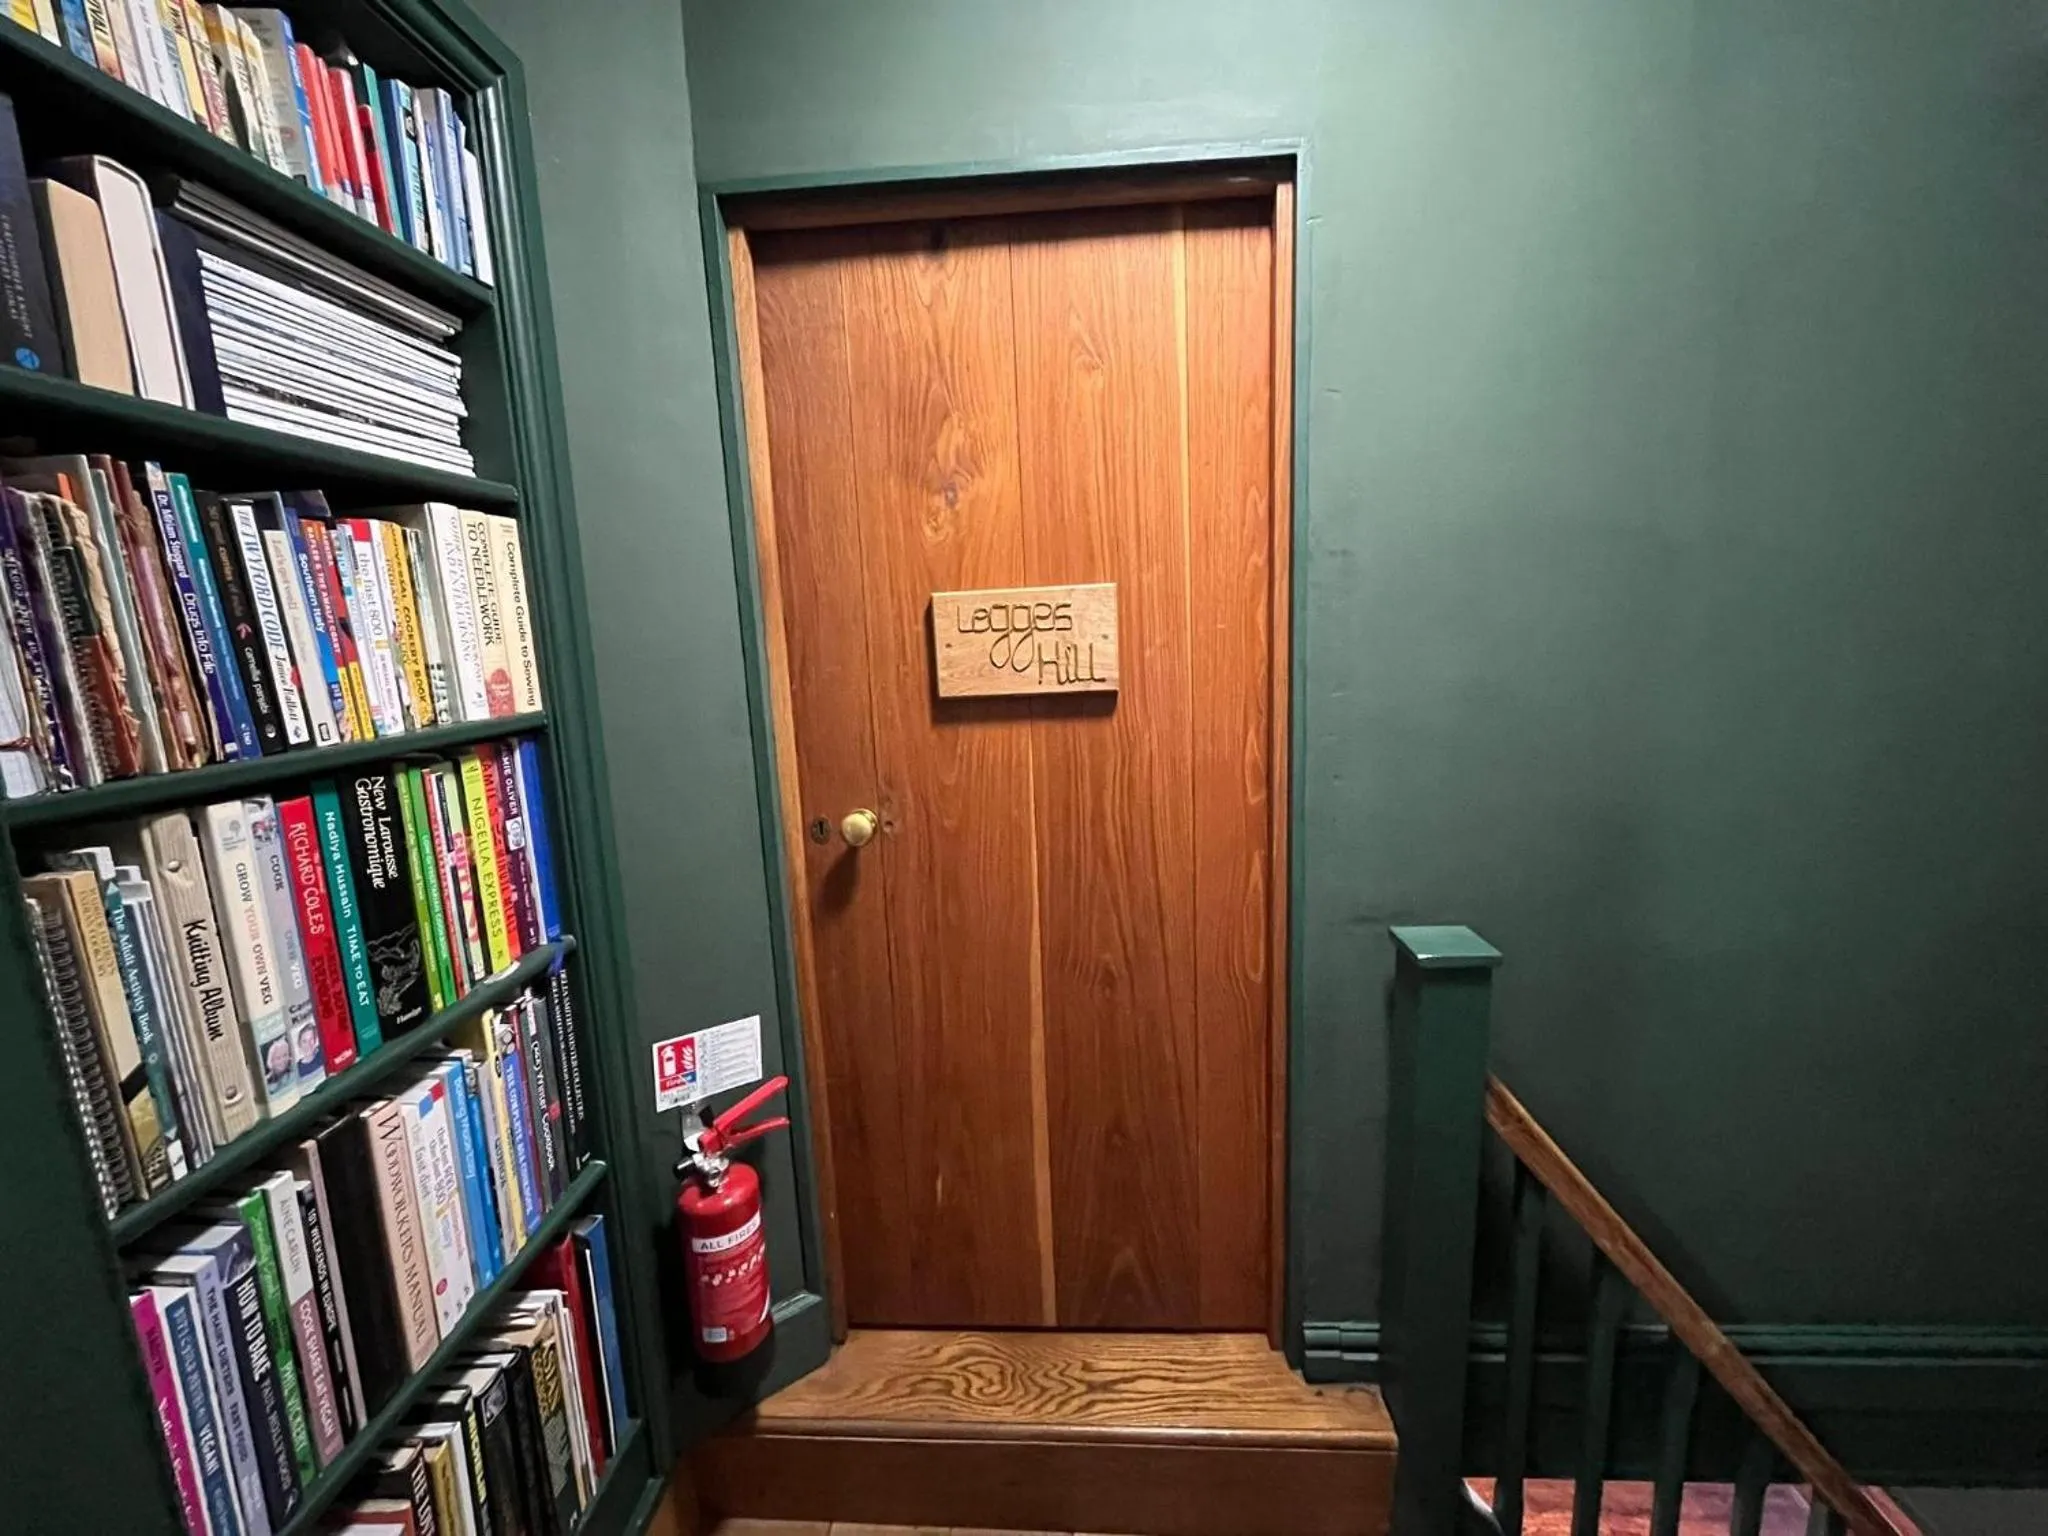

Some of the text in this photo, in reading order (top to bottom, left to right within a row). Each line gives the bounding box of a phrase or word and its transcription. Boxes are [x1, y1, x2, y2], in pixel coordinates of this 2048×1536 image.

[156, 492, 189, 579] Dr. Miriam Stoppard
[306, 526, 319, 560] NAPLES
[241, 528, 274, 610] TWYFORD
[262, 608, 285, 651] CODE
[298, 551, 319, 607] Southern
[311, 607, 325, 633] Italy
[316, 572, 326, 588] THE
[320, 590, 334, 623] AMALFI
[358, 552, 383, 636] the fast 800
[466, 522, 495, 646] TO NEEDLEWORK
[478, 521, 501, 642] COMPLETE GUIDE
[182, 591, 215, 675] Drugs Info File
[329, 624, 341, 653] COAST
[504, 540, 537, 706] Complete Guide to Sewing
[273, 653, 293, 686] Janice
[402, 605, 420, 665] COOKERY
[414, 669, 426, 702] BOOK
[1038, 641, 1106, 685] Hill
[504, 777, 518, 814] OLIVER
[285, 821, 318, 885] RICHARD
[356, 778, 387, 889] Gastronomique
[371, 776, 397, 878] New Larousse
[321, 810, 343, 860] Nadiya
[333, 863, 353, 918] Hussain
[470, 797, 503, 937] NIGELLA EXPRESS
[233, 860, 273, 1005] GROW YOUR OWN VEG
[268, 854, 285, 891] COOK
[288, 961, 304, 989] VEG
[300, 884, 327, 936] COLES
[111, 905, 156, 1044] The Adult Activity Book
[183, 918, 225, 1042] Knitting Album
[344, 924, 369, 1005] TIME TO EAT
[505, 1064, 516, 1089] THE
[567, 1032, 578, 1065] WINTER
[508, 1089, 524, 1140] COMPLETE
[535, 1071, 549, 1110] Winter
[413, 1146, 428, 1170] fast
[430, 1158, 443, 1179] fast
[438, 1144, 451, 1166] fast
[541, 1115, 557, 1171] Cookbook
[417, 1171, 435, 1198] diet
[518, 1162, 534, 1214] COOKBOOK
[306, 1208, 317, 1224] 101
[700, 1222, 757, 1250] ALL FIRES
[308, 1225, 329, 1280] WEEKENDS
[233, 1278, 274, 1381] HOW TO BAKE
[320, 1291, 339, 1331] EUROPE
[403, 1262, 428, 1342] MANUAL
[204, 1286, 235, 1396] THE HAIRY DIETERS
[298, 1297, 335, 1437] COOK SHARE EAT VEGAN
[278, 1361, 298, 1395] PHIL
[228, 1402, 242, 1429] FAST
[258, 1377, 295, 1491] PAUL HOLLYWOOD
[411, 1456, 429, 1504] THE
